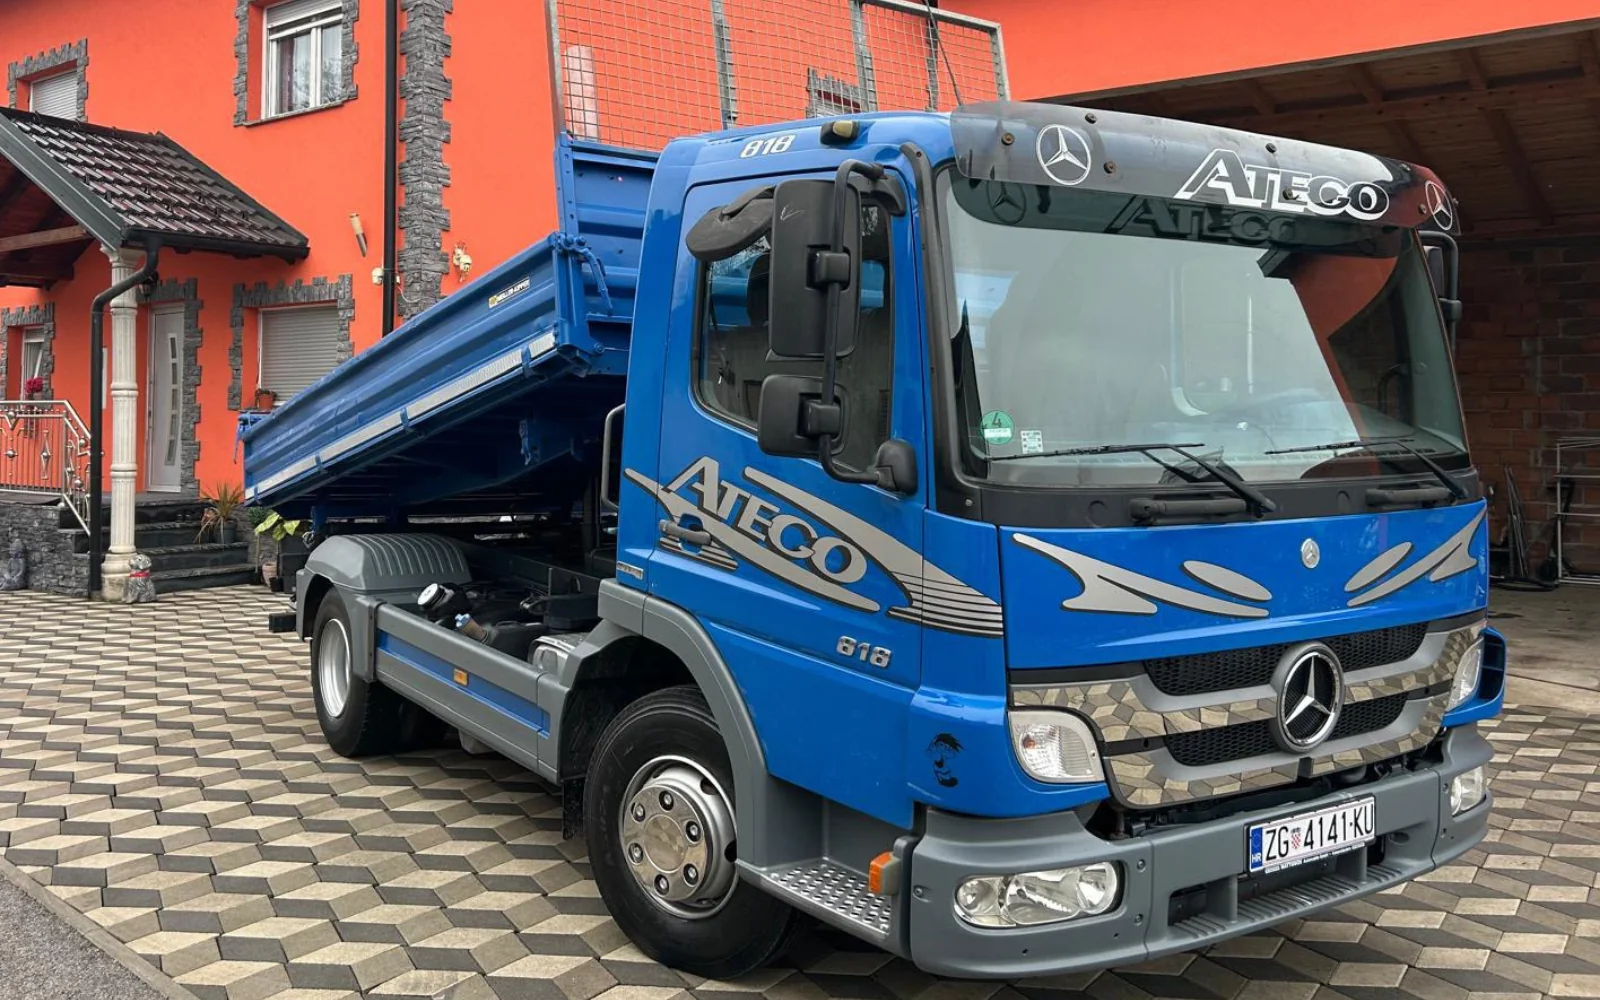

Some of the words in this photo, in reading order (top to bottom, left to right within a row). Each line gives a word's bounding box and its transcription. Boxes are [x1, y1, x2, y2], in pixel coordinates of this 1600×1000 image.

[740, 134, 797, 158] 818
[1173, 148, 1390, 221] ATEGO
[992, 412, 1002, 428] 4
[660, 456, 868, 584] ATEGO
[836, 635, 892, 668] 818
[1251, 853, 1262, 863] HR
[1265, 826, 1289, 861] ZG
